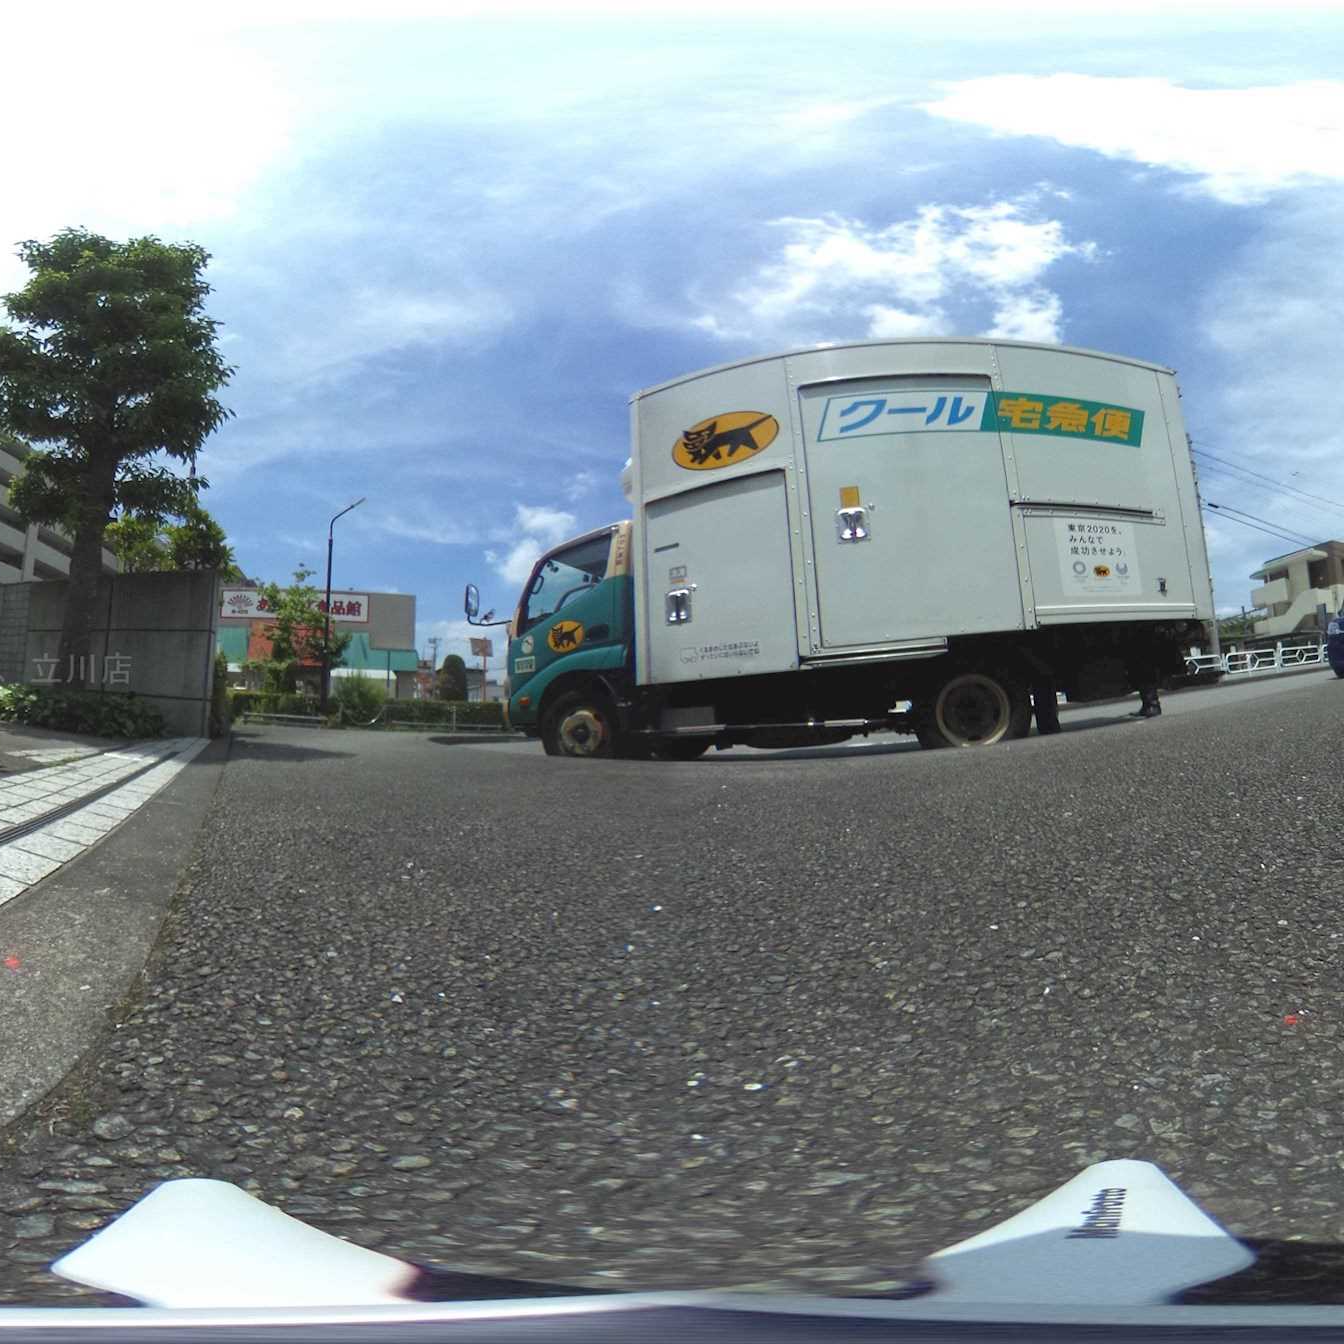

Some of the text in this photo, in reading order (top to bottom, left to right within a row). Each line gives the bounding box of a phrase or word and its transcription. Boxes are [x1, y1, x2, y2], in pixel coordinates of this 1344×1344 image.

[839, 396, 1132, 440] クール 宅急便
[1064, 1188, 1127, 1239] Manfrotto
